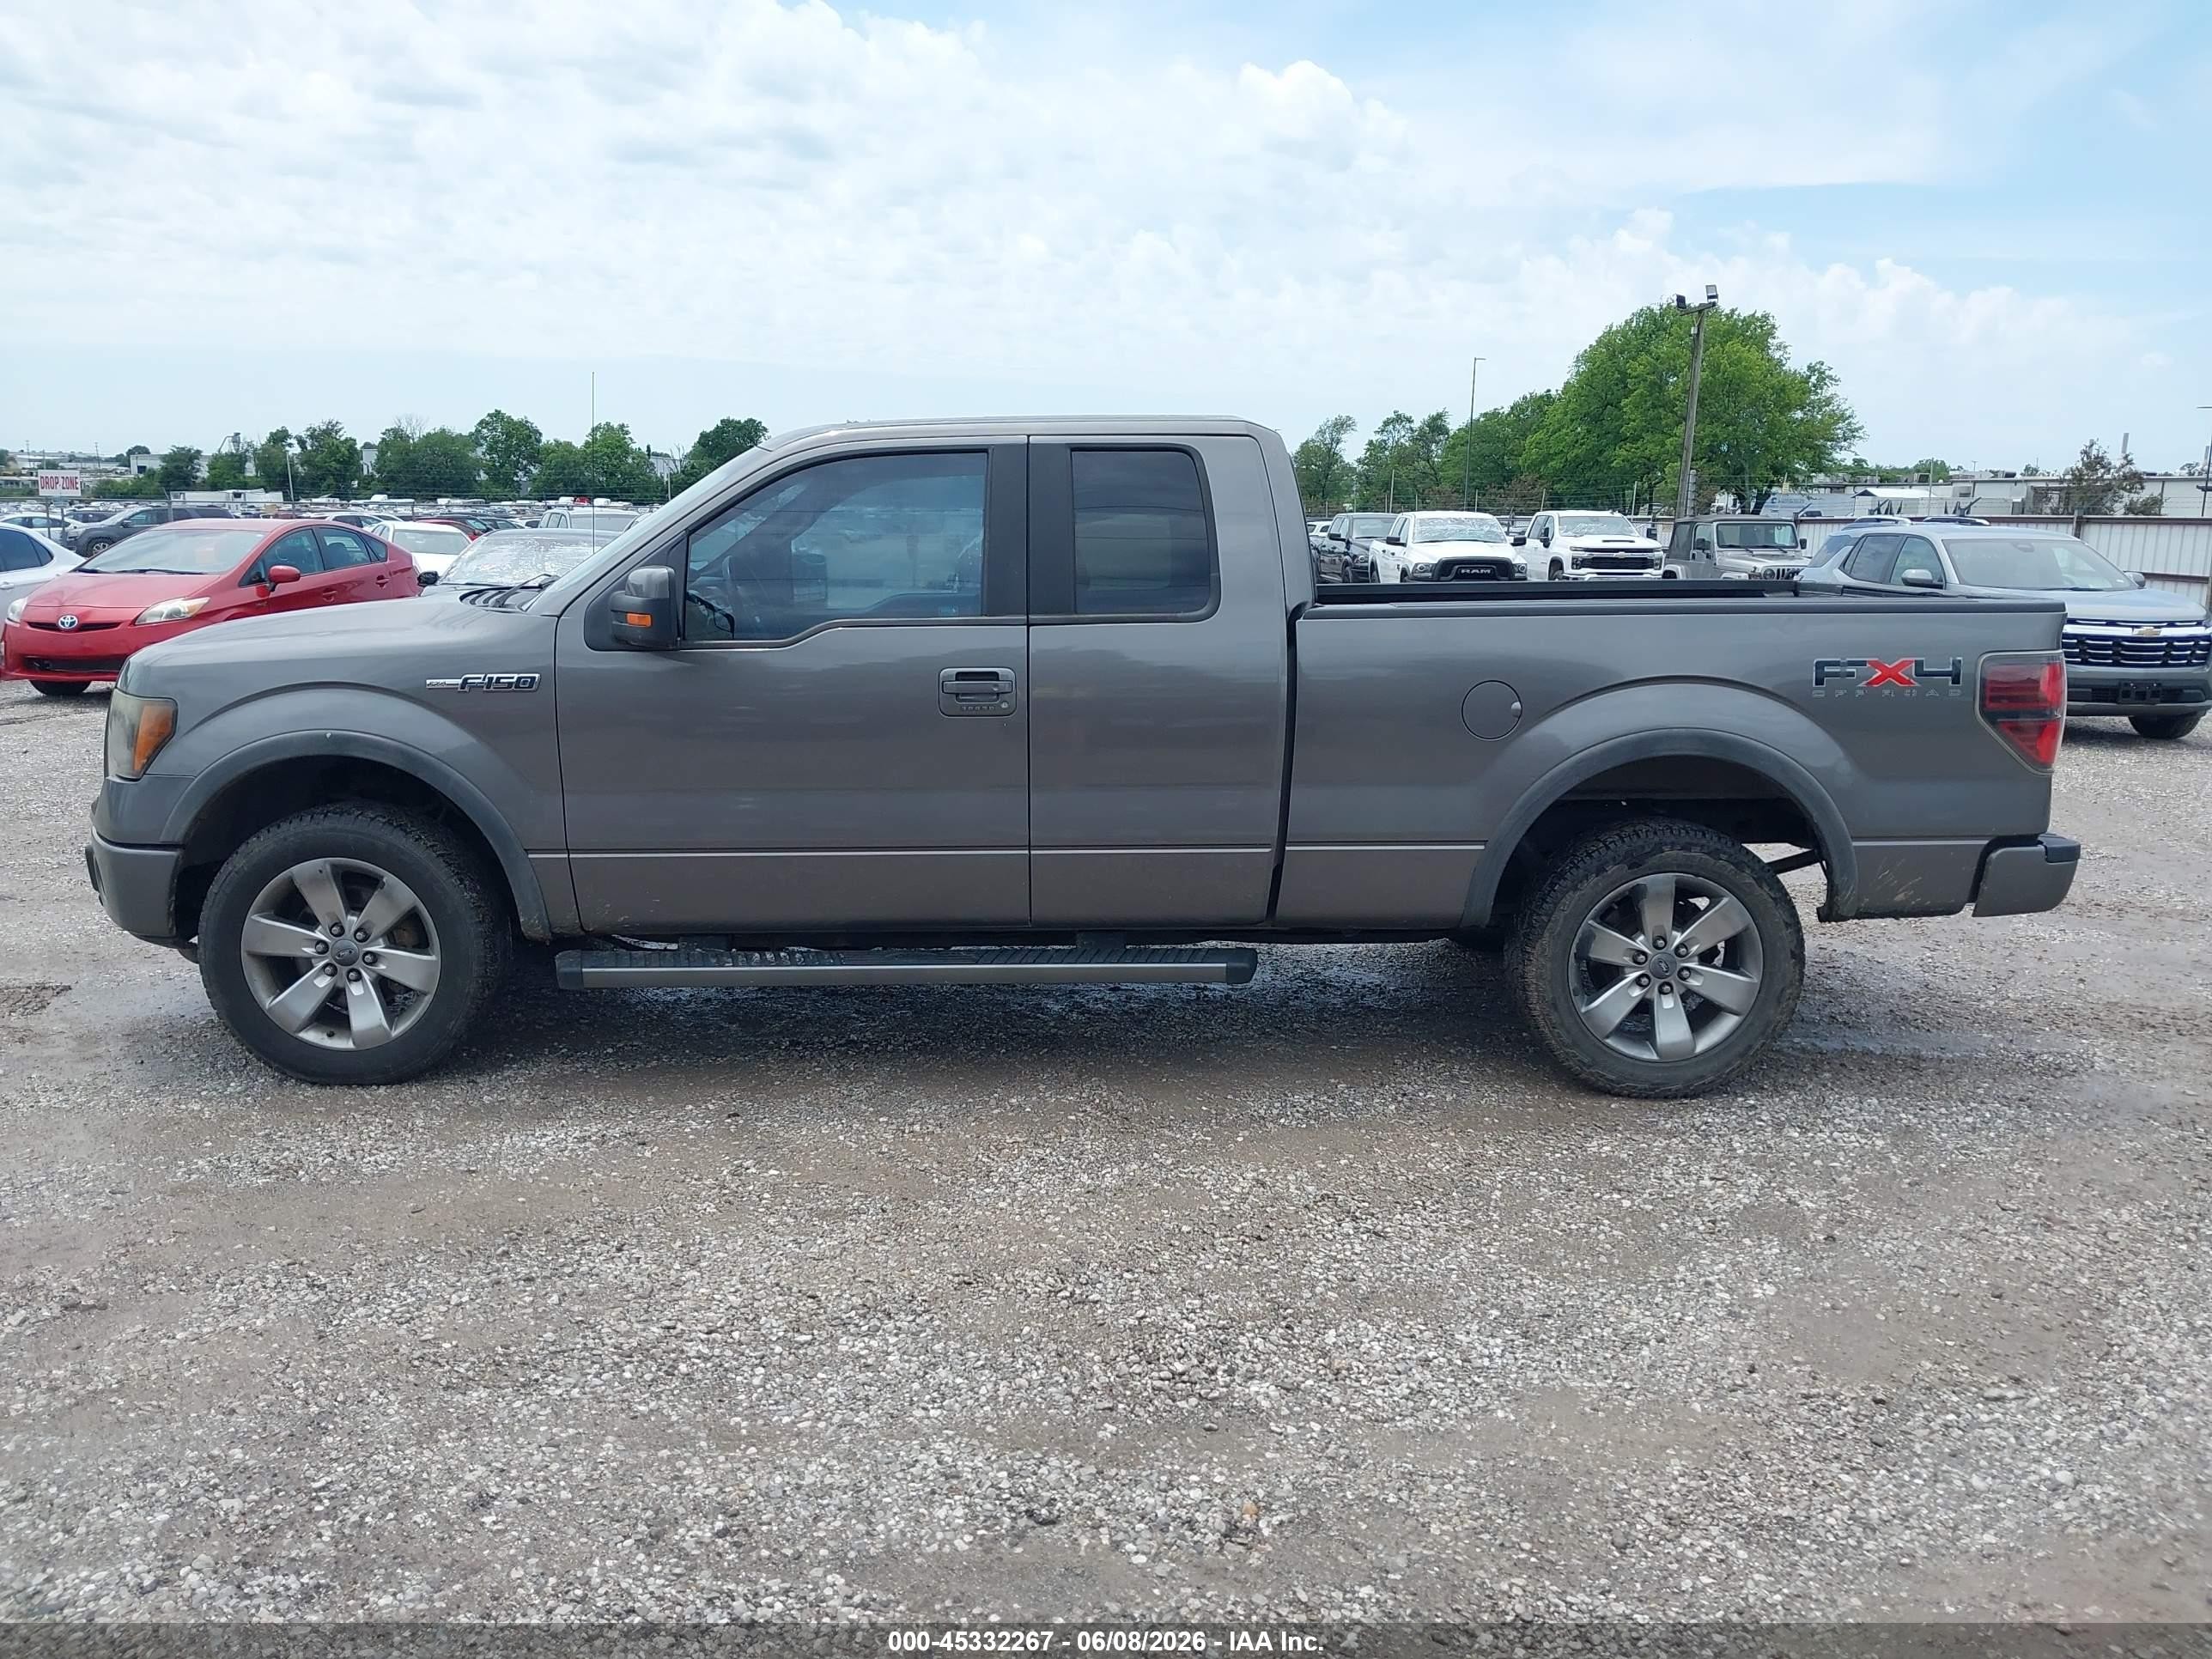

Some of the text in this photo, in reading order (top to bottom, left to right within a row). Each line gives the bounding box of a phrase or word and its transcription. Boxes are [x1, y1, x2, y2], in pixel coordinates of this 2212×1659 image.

[40, 476, 79, 490] DROP ZONE
[457, 673, 543, 693] F-150
[1813, 658, 1963, 688] FX4
